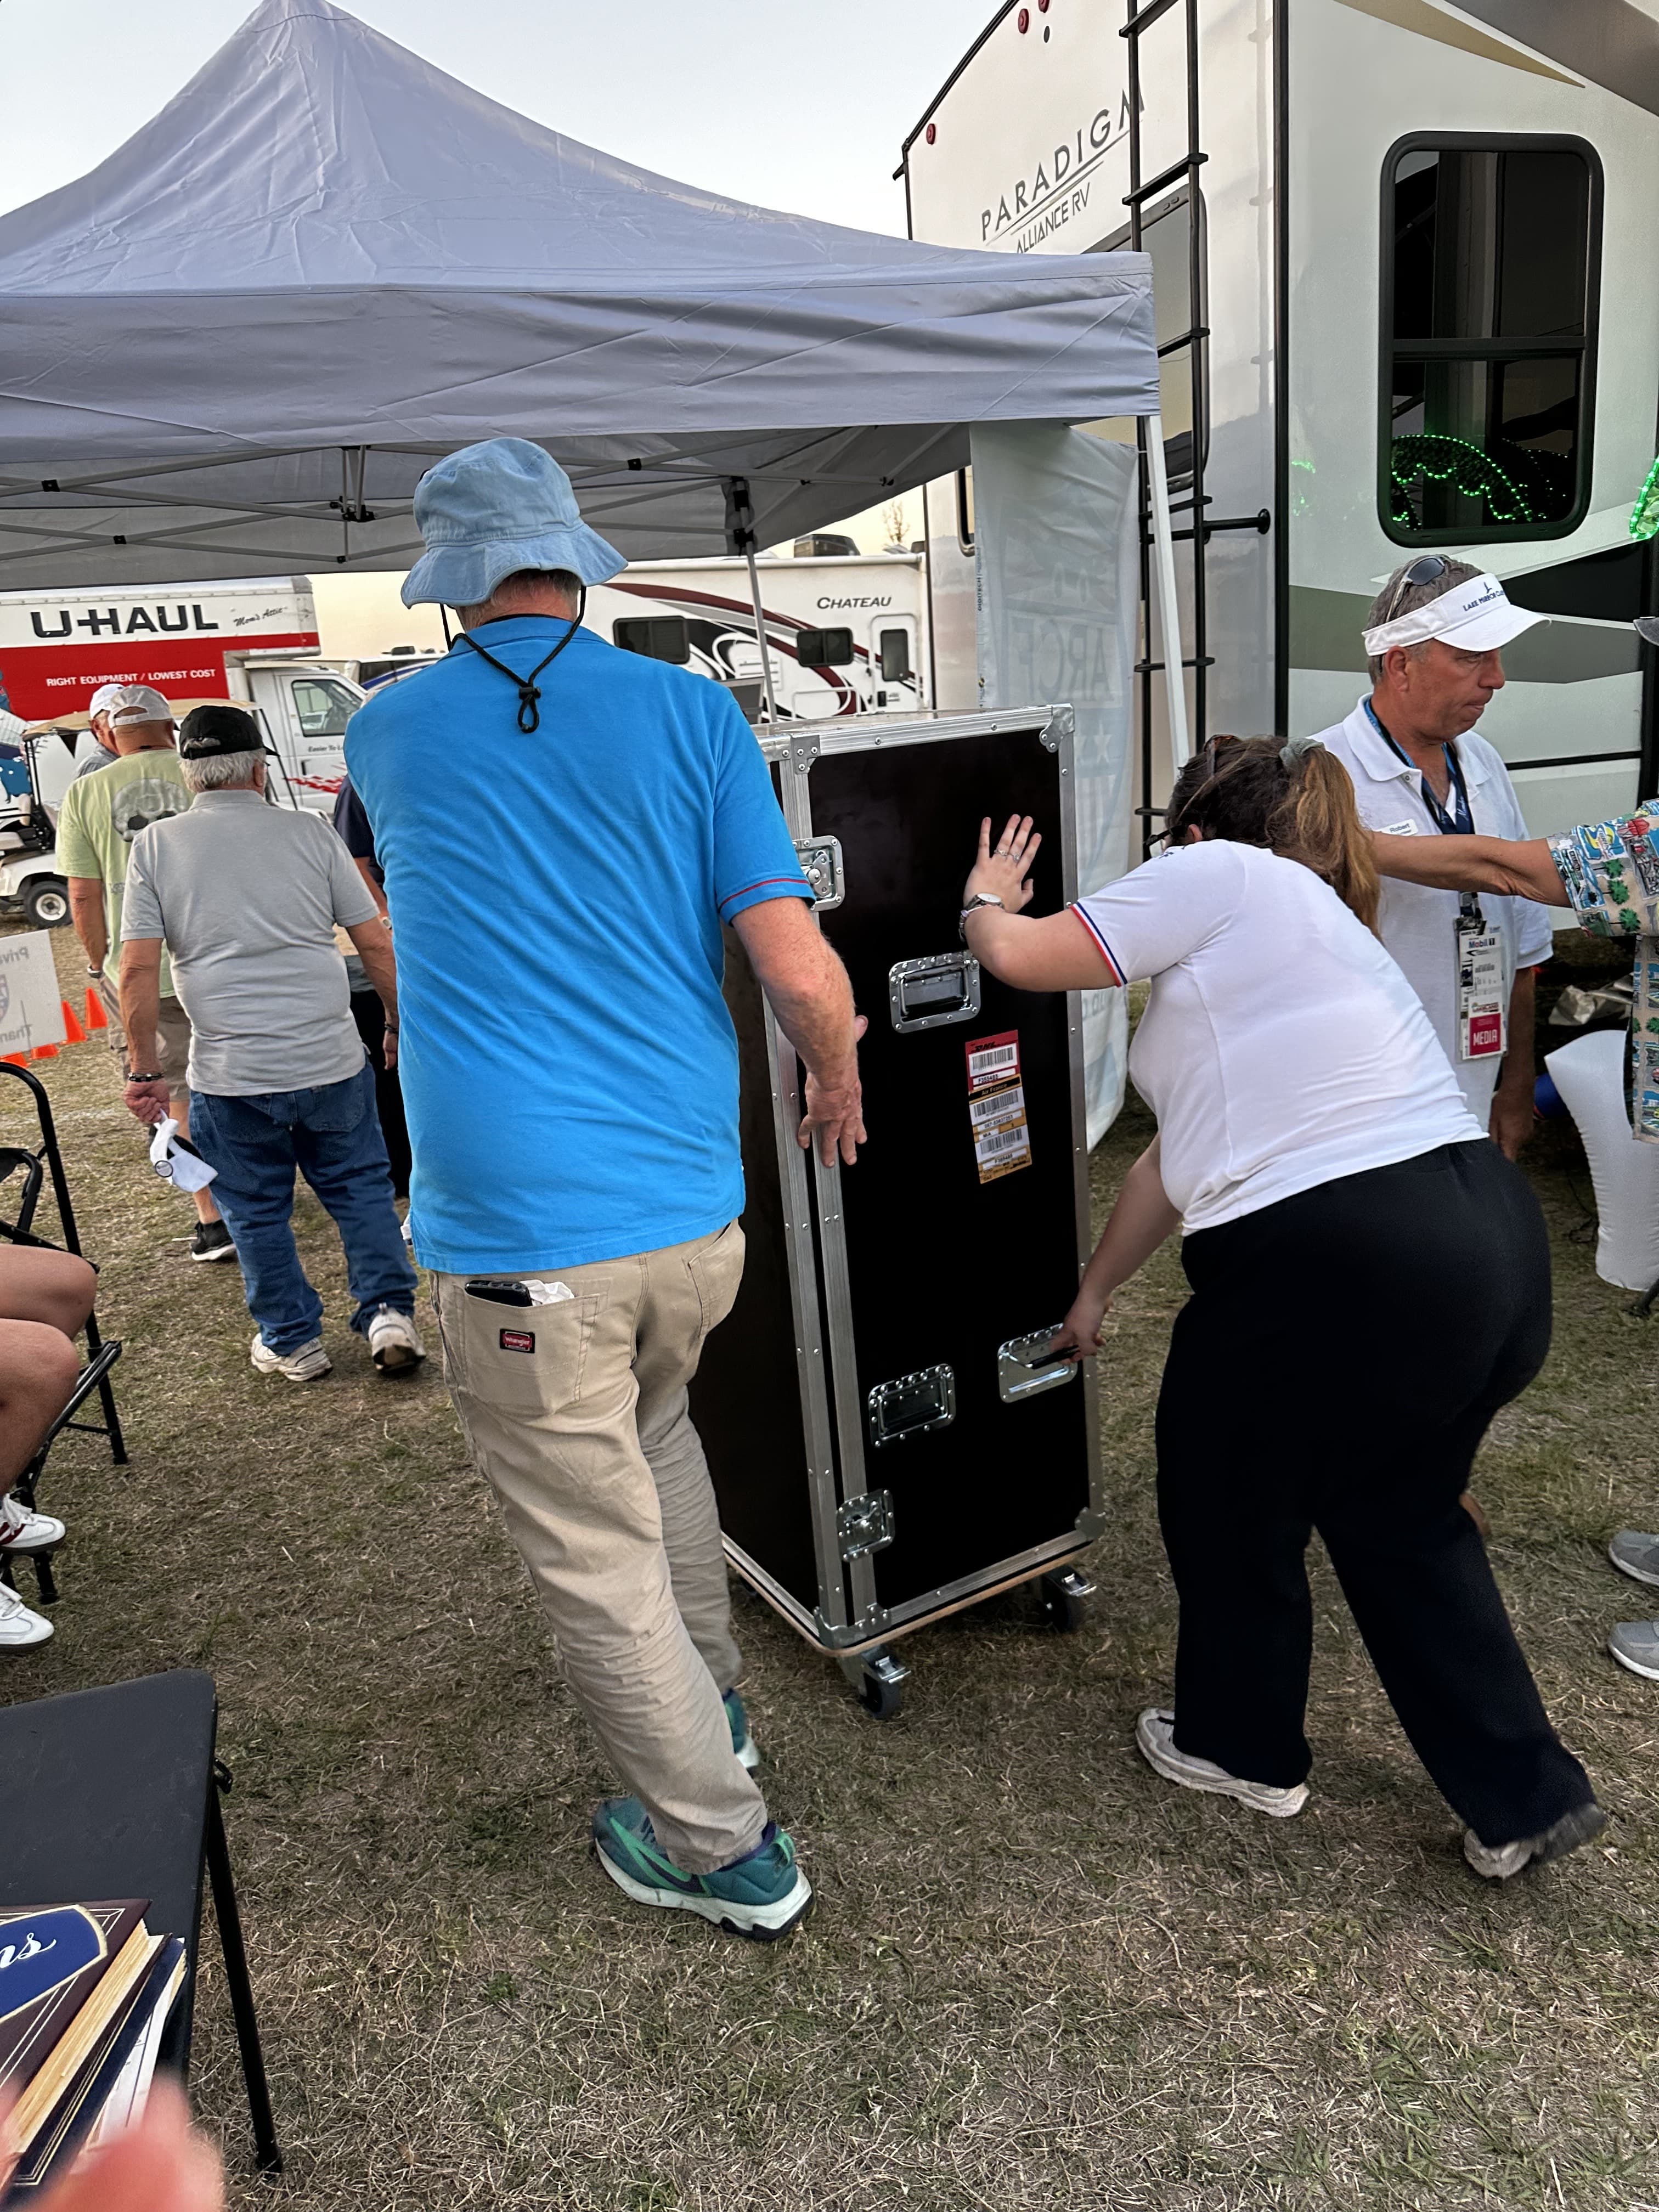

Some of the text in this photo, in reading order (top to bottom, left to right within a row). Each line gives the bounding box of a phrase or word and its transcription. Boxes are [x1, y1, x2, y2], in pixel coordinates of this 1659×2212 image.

[1017, 182, 1090, 253] ALLIANCE RV
[1463, 600, 1479, 612] LAKE
[46, 676, 77, 686] RIGHT
[80, 673, 138, 685] EQUIPMENT
[148, 670, 188, 680] LOWEST
[190, 668, 216, 678] COST
[1390, 823, 1410, 833] Robert
[1469, 939, 1488, 949] Mobil
[1473, 1029, 1498, 1046] MEDIA
[990, 1084, 1008, 1093] France
